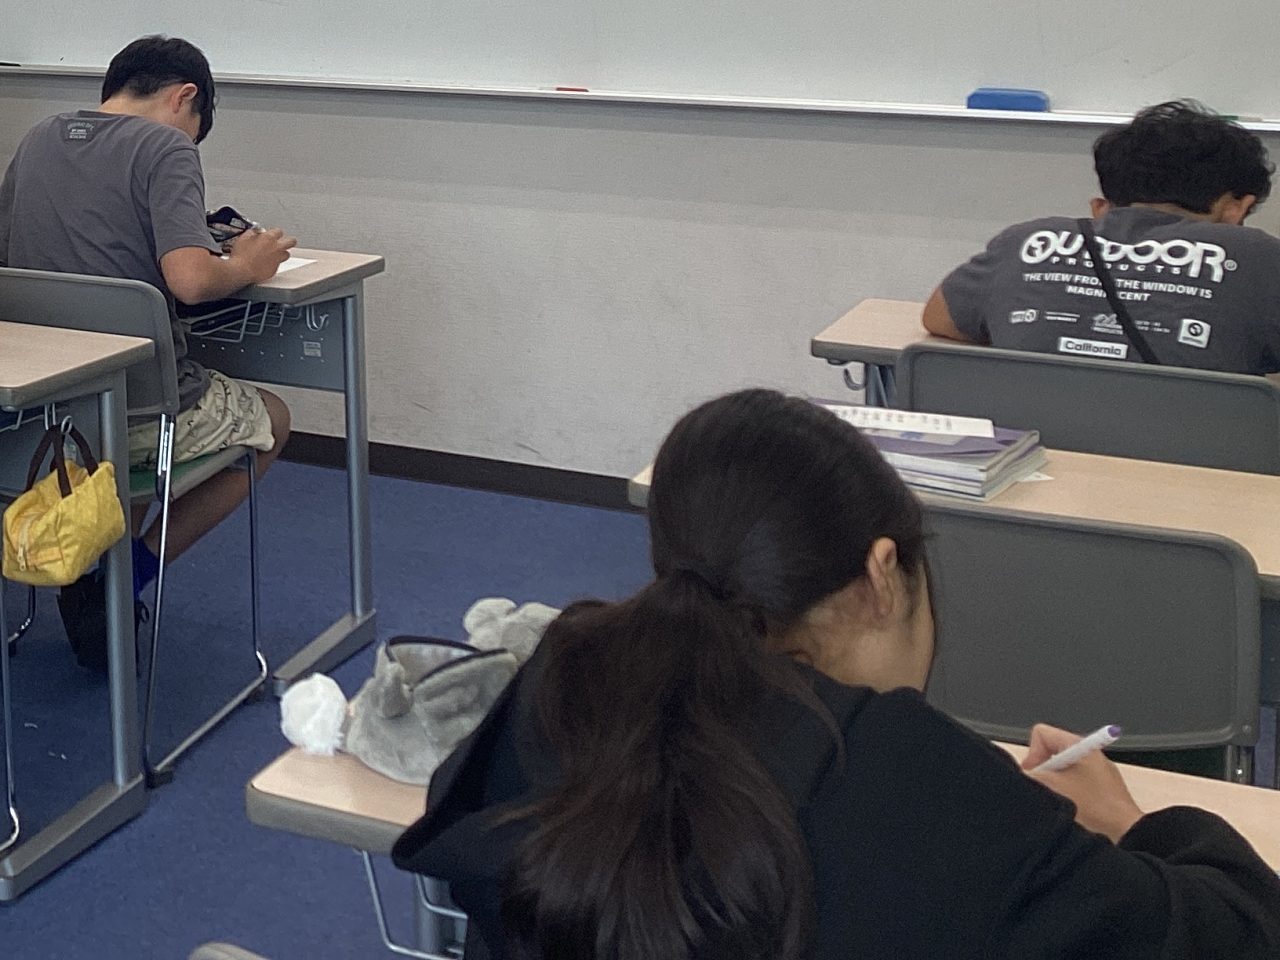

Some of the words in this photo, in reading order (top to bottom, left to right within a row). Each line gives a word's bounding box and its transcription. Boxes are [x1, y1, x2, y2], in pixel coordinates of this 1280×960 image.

[1024, 273, 1042, 282] THE
[1044, 273, 1072, 283] VIEW
[1074, 274, 1103, 287] FRO
[1115, 279, 1141, 290] THE
[1143, 282, 1198, 296] WINDOW
[1200, 288, 1213, 299] IS
[1065, 340, 1122, 357] California
